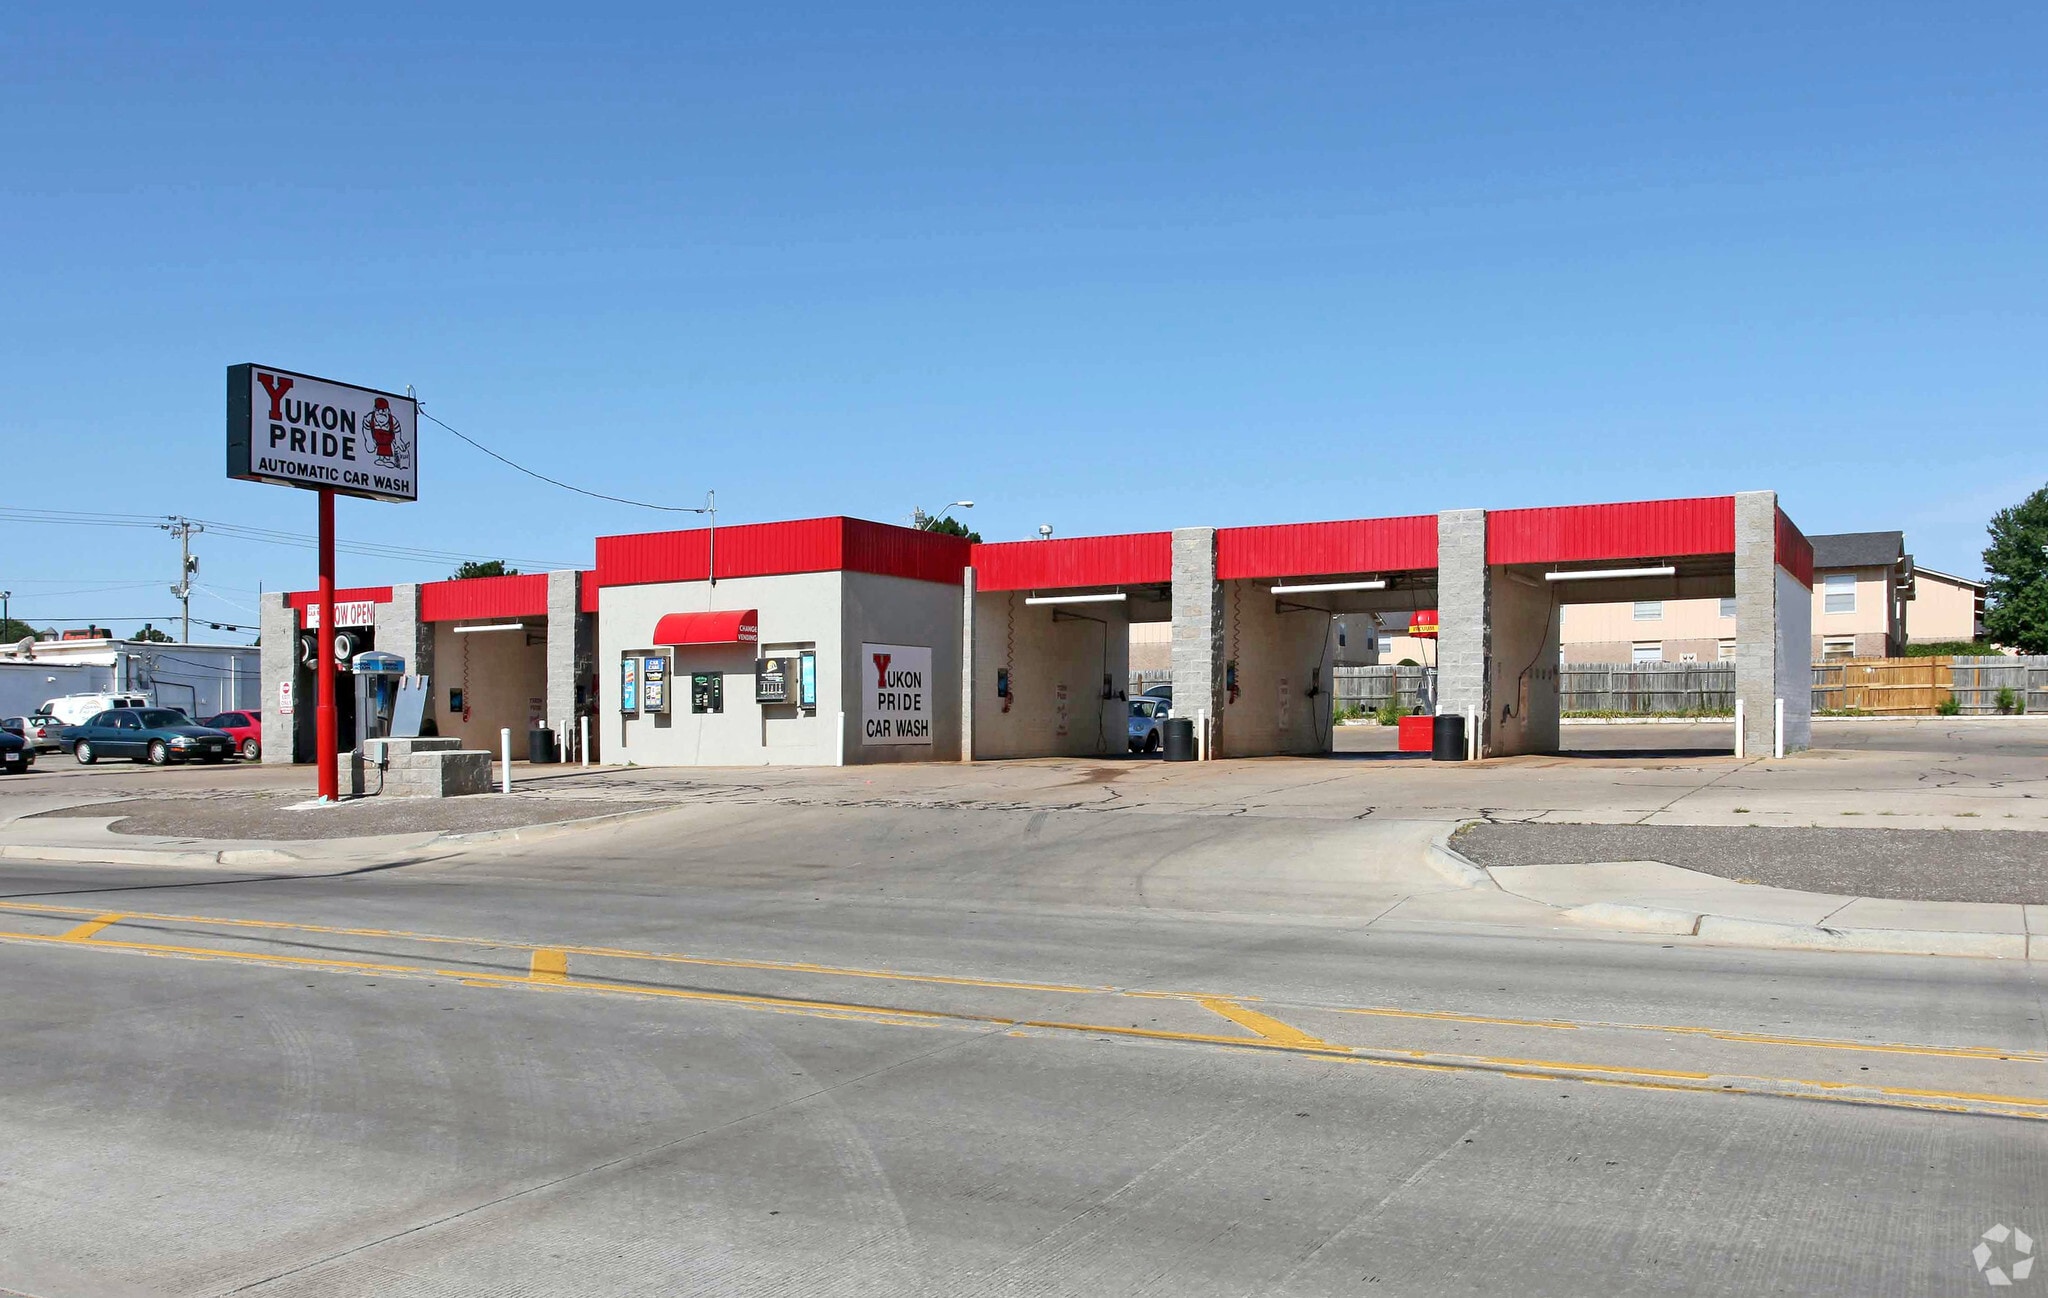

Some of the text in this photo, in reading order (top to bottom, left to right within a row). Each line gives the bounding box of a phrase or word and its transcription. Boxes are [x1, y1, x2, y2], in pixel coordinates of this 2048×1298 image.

[257, 373, 356, 434] YUKON
[269, 424, 356, 461] PRIDE
[258, 457, 410, 493] AUTOMATIC CAR WASH
[335, 603, 373, 625] OW OPEN
[872, 653, 921, 689] YUKON
[878, 692, 921, 711] PRIDE
[866, 719, 929, 737] CAR WASH
